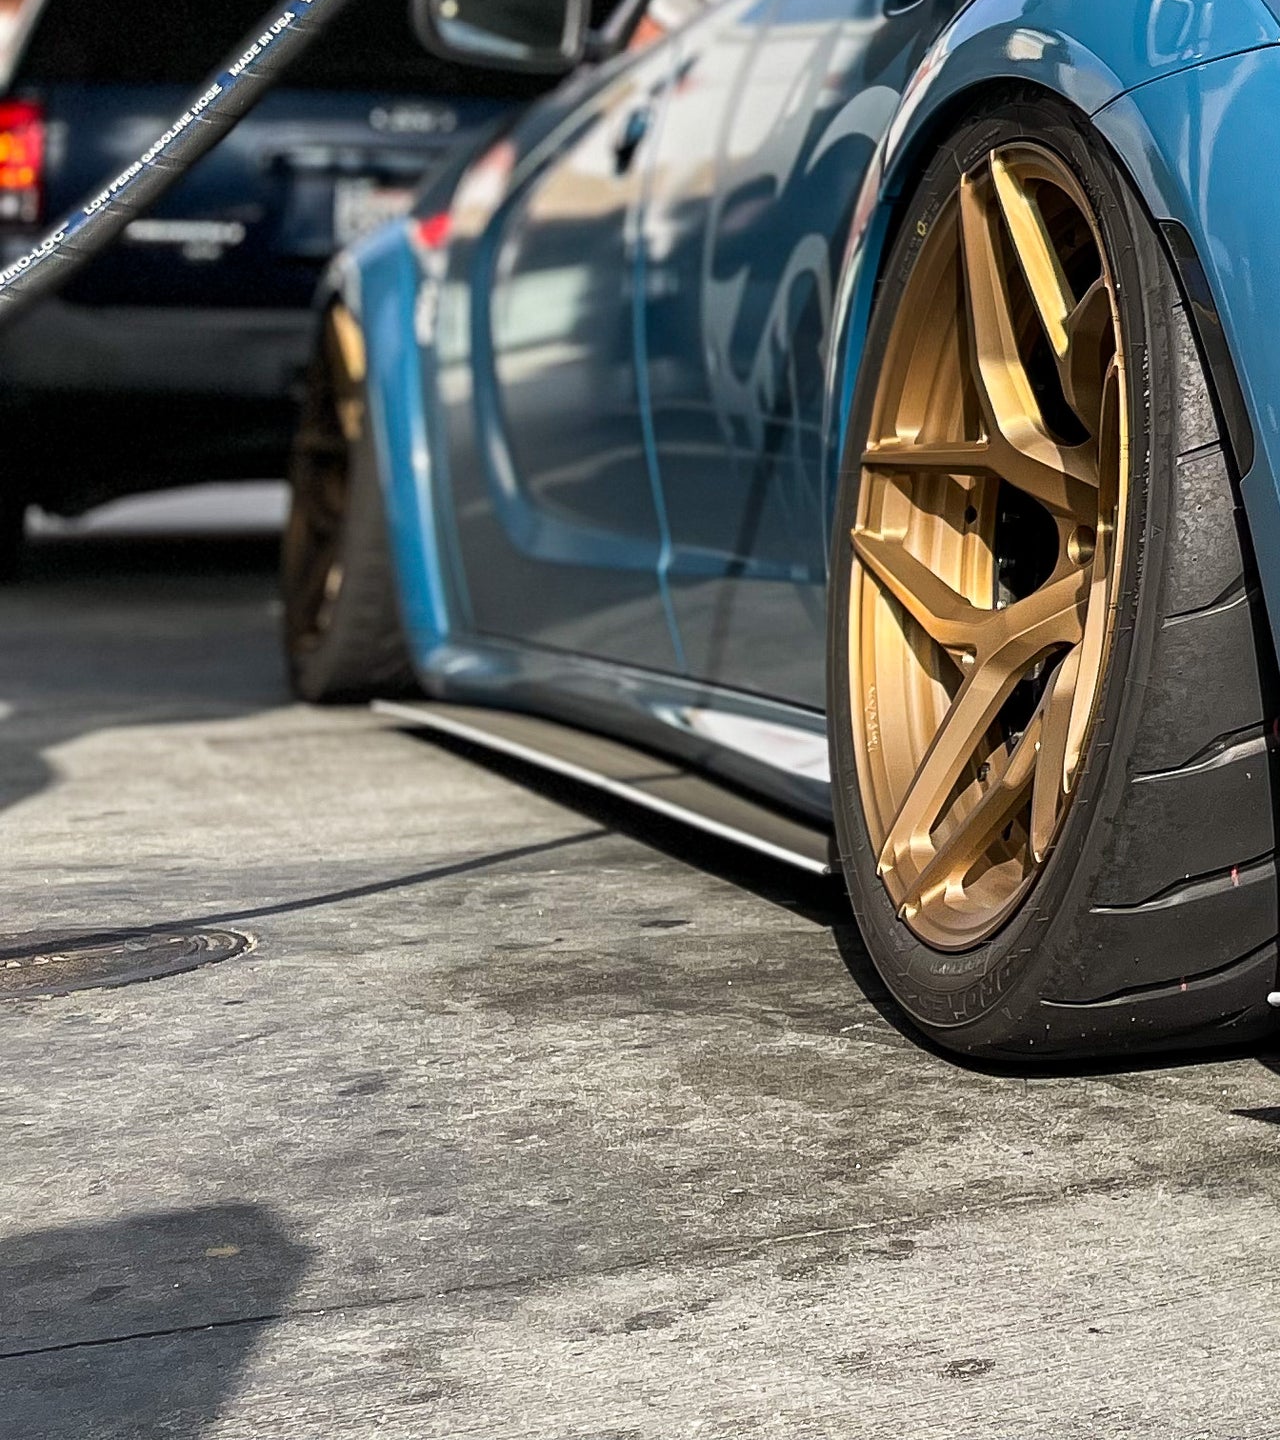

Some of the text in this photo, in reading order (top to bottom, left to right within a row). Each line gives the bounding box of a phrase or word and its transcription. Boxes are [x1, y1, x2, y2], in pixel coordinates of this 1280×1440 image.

[228, 11, 296, 77] MADE IN USA
[84, 83, 223, 216] LOW PERM GASOLINE HOSE
